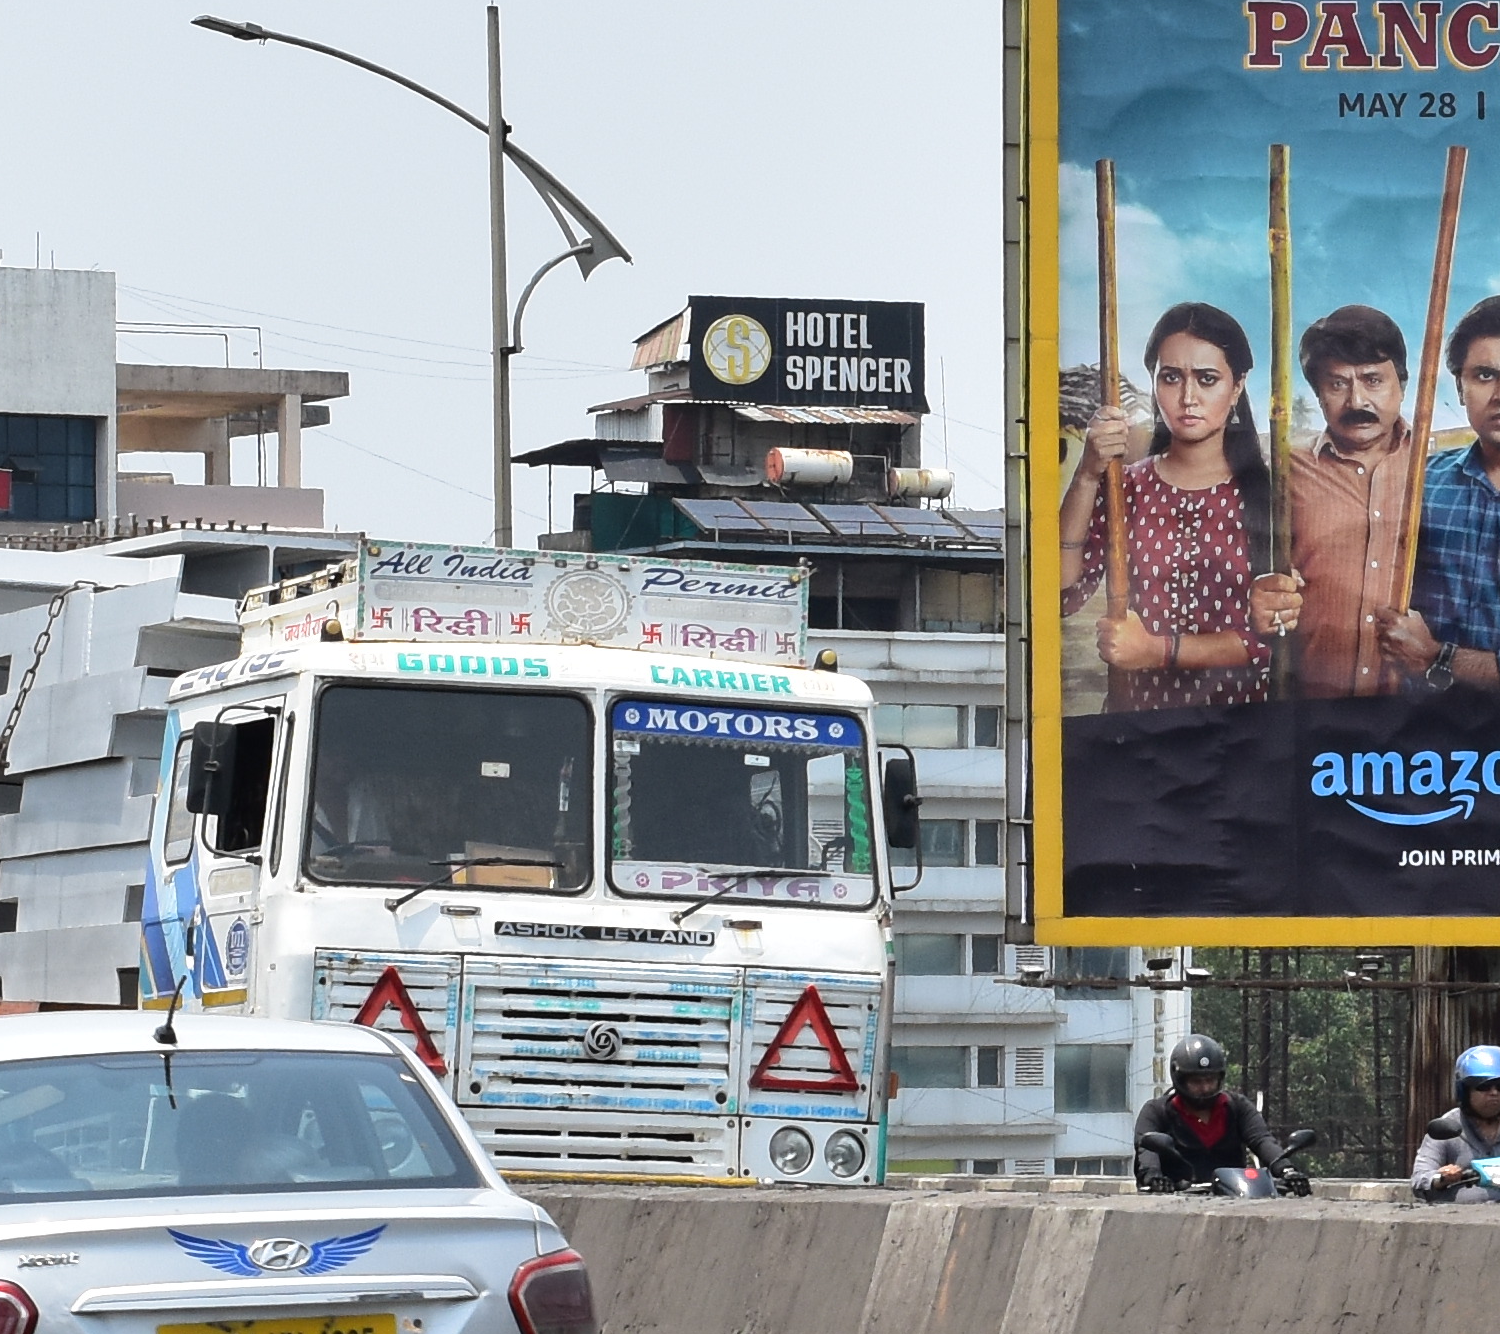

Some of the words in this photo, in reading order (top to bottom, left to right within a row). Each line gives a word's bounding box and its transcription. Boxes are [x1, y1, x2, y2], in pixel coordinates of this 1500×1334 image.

[1339, 93, 1407, 118] MAY
[1419, 92, 1457, 118] 28
[786, 311, 872, 349] HOTEL
[786, 356, 913, 393] SPENCER
[370, 551, 433, 575] All
[444, 555, 533, 581] India
[641, 568, 798, 598] Permit
[397, 653, 550, 677] GOODS
[650, 665, 793, 694] CARRIER
[646, 708, 819, 740] MOTORS
[1399, 850, 1446, 867] JOIN
[500, 923, 585, 940] ASHOK
[601, 928, 713, 946] LEYLAND
